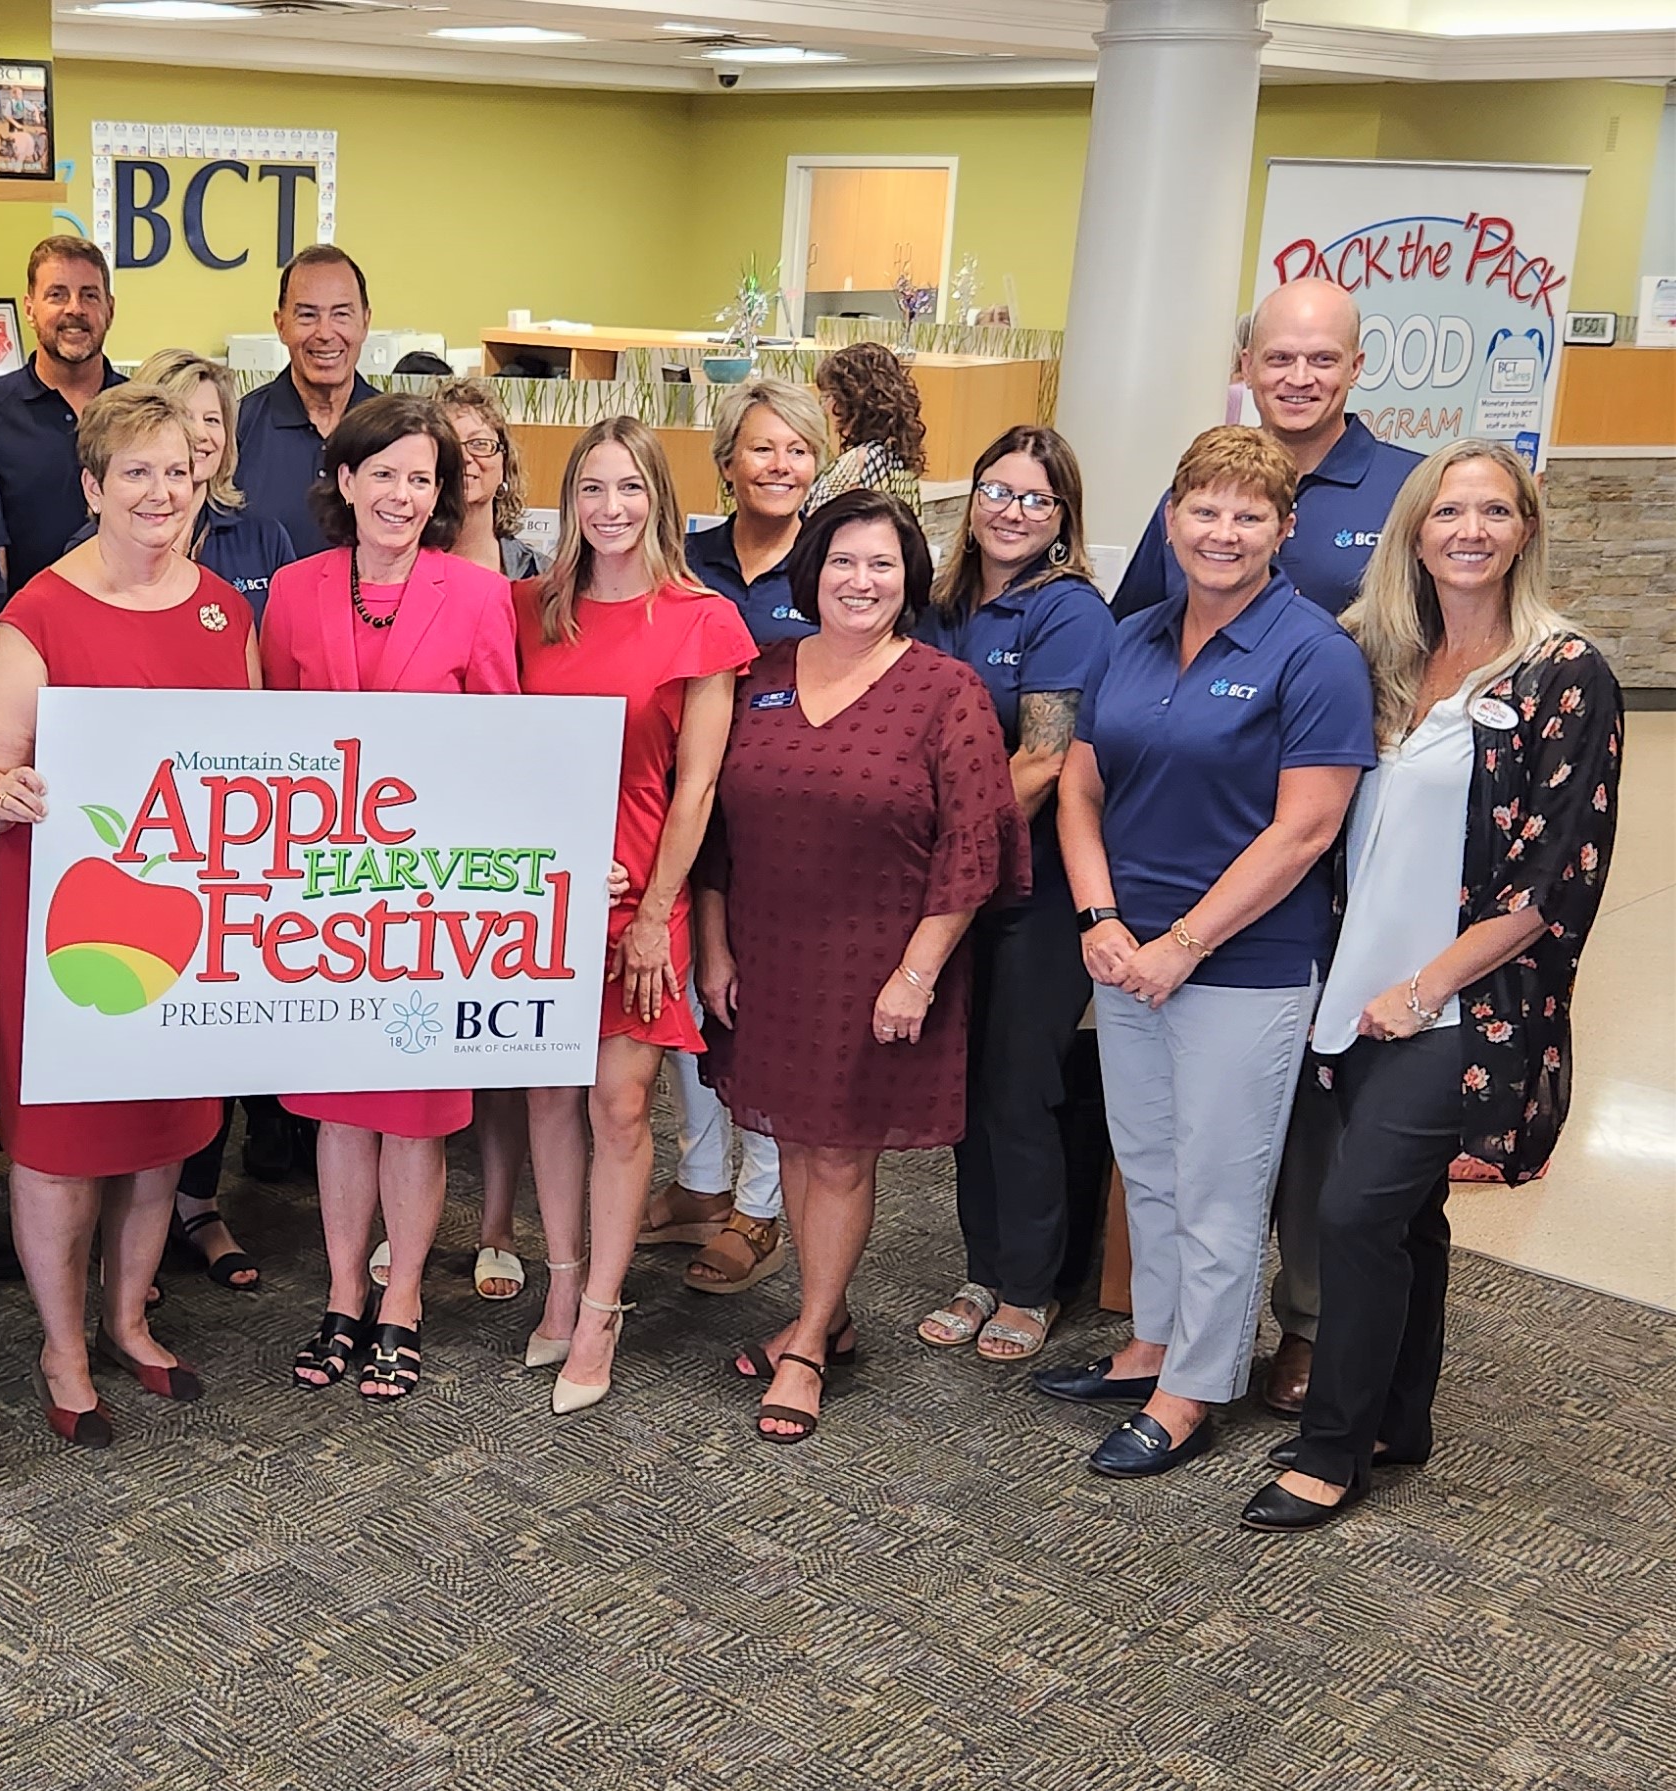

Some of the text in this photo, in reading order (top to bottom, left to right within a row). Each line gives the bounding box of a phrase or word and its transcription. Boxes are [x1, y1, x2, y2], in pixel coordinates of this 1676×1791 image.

[115, 159, 317, 270] BCT
[1273, 236, 1393, 294] PACK
[1397, 223, 1452, 282] the
[1355, 313, 1474, 391] OOD
[1498, 361, 1518, 373] BCT
[1505, 372, 1531, 381] Cares
[1481, 399, 1538, 408] Monetary donations
[1484, 410, 1511, 419] accepted
[1512, 411, 1520, 419] by
[1357, 407, 1464, 441] OGRAM
[527, 521, 550, 531] BCT
[246, 577, 269, 590] BCT
[1003, 651, 1023, 665] BC
[1227, 684, 1259, 700] BCT
[175, 750, 341, 771] Mountain State
[112, 738, 417, 879] Apple
[302, 847, 556, 899] HARVEST
[195, 871, 575, 983] Festival
[160, 998, 389, 1027] PRESENTED BY
[455, 999, 556, 1040] BCT
[389, 1035, 437, 1048] 18 71
[454, 1042, 581, 1054] BANK OF CHARLES TOWN
